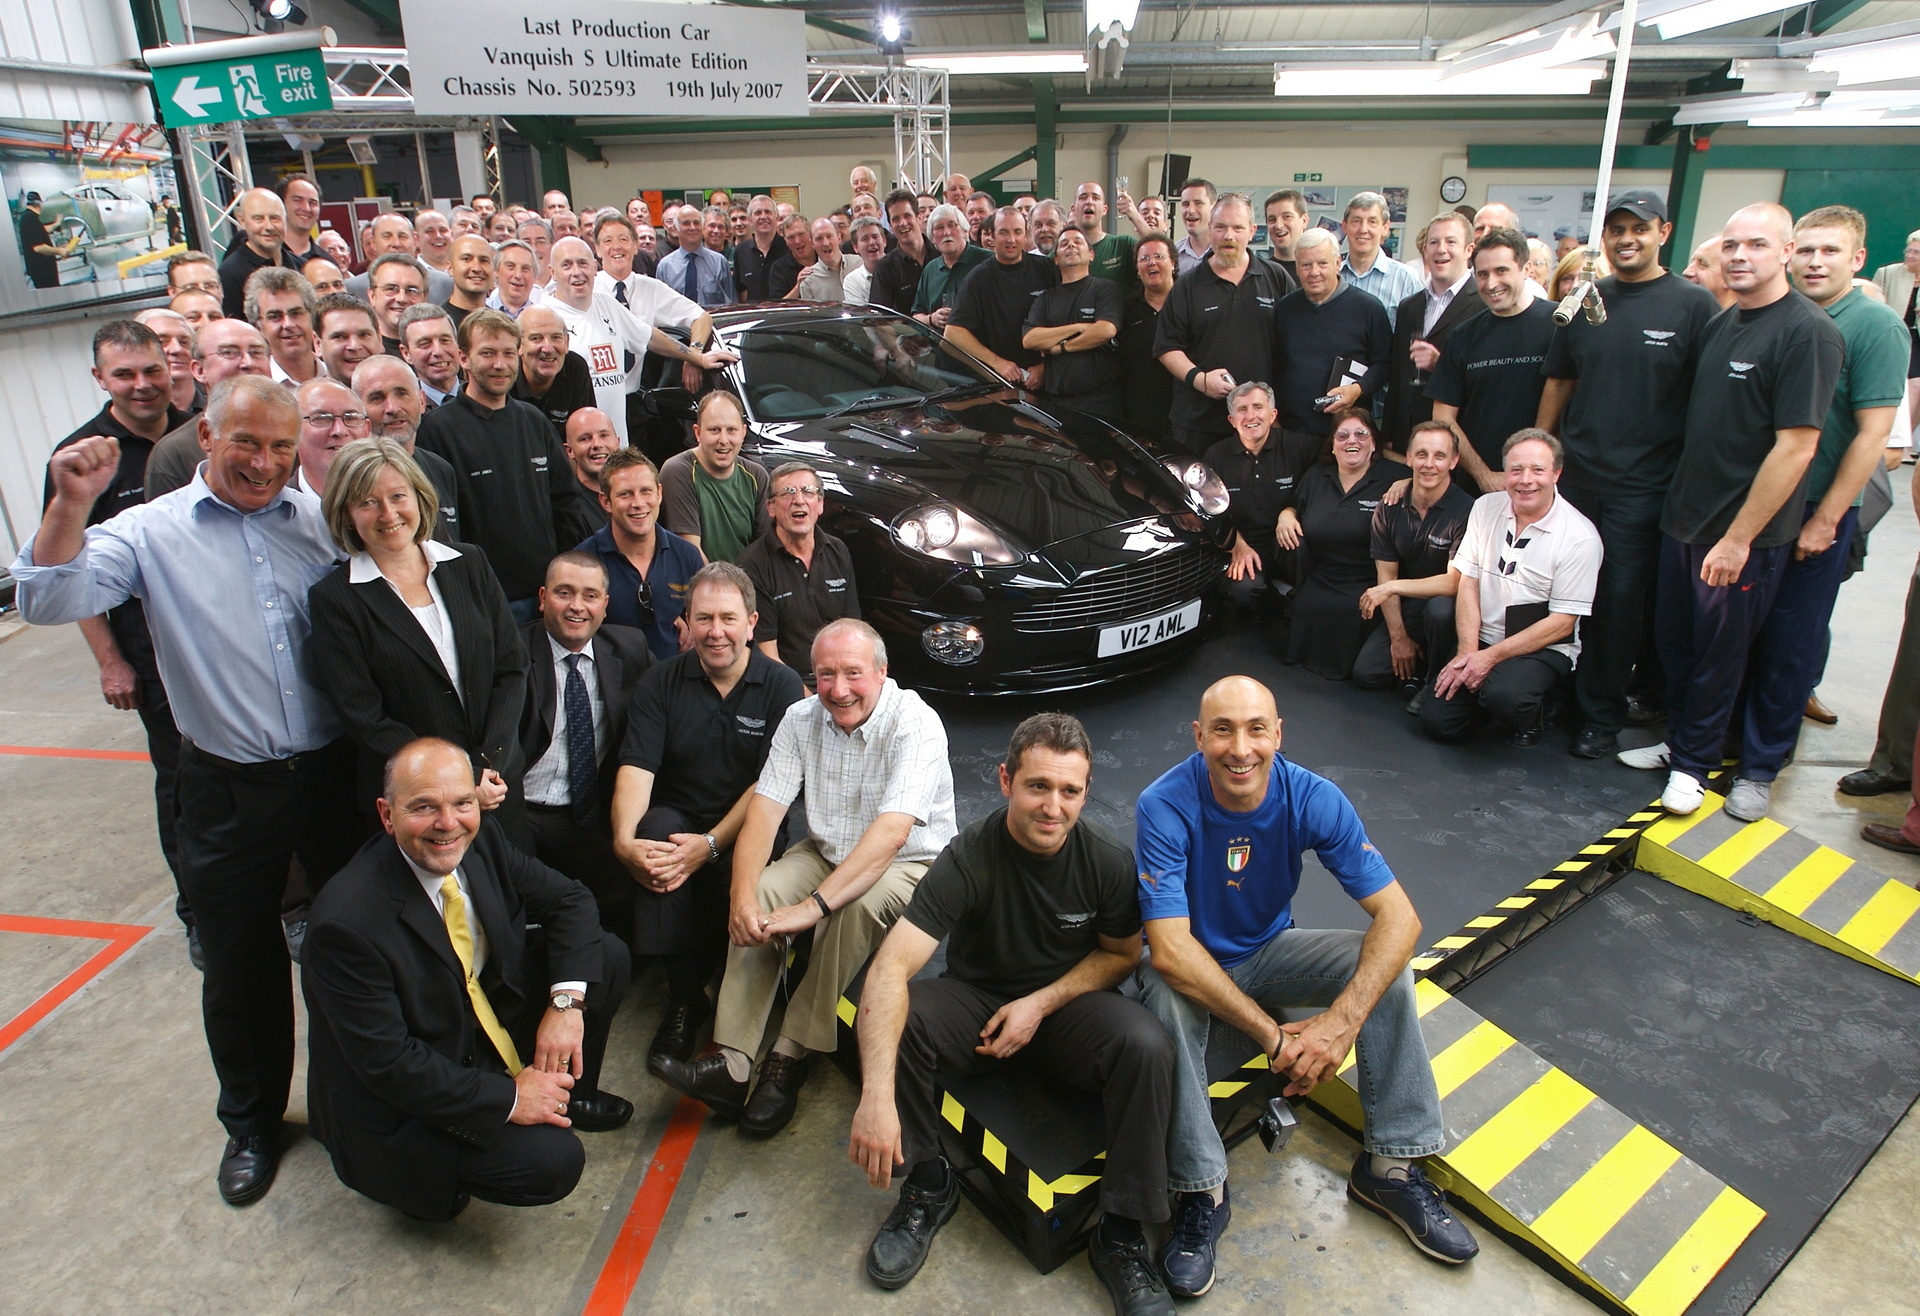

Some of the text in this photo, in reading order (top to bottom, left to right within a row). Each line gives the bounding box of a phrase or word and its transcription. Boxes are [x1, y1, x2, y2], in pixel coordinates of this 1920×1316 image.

[523, 17, 710, 41] Last Production Car
[483, 46, 748, 71] Vanquish S Ultimate Edition
[274, 63, 312, 83] Fire
[281, 81, 317, 102] exit
[443, 76, 783, 103] Chassis No. 502593 19th July 2007
[593, 374, 625, 387] ANSION
[1121, 612, 1186, 650] V12 AML
